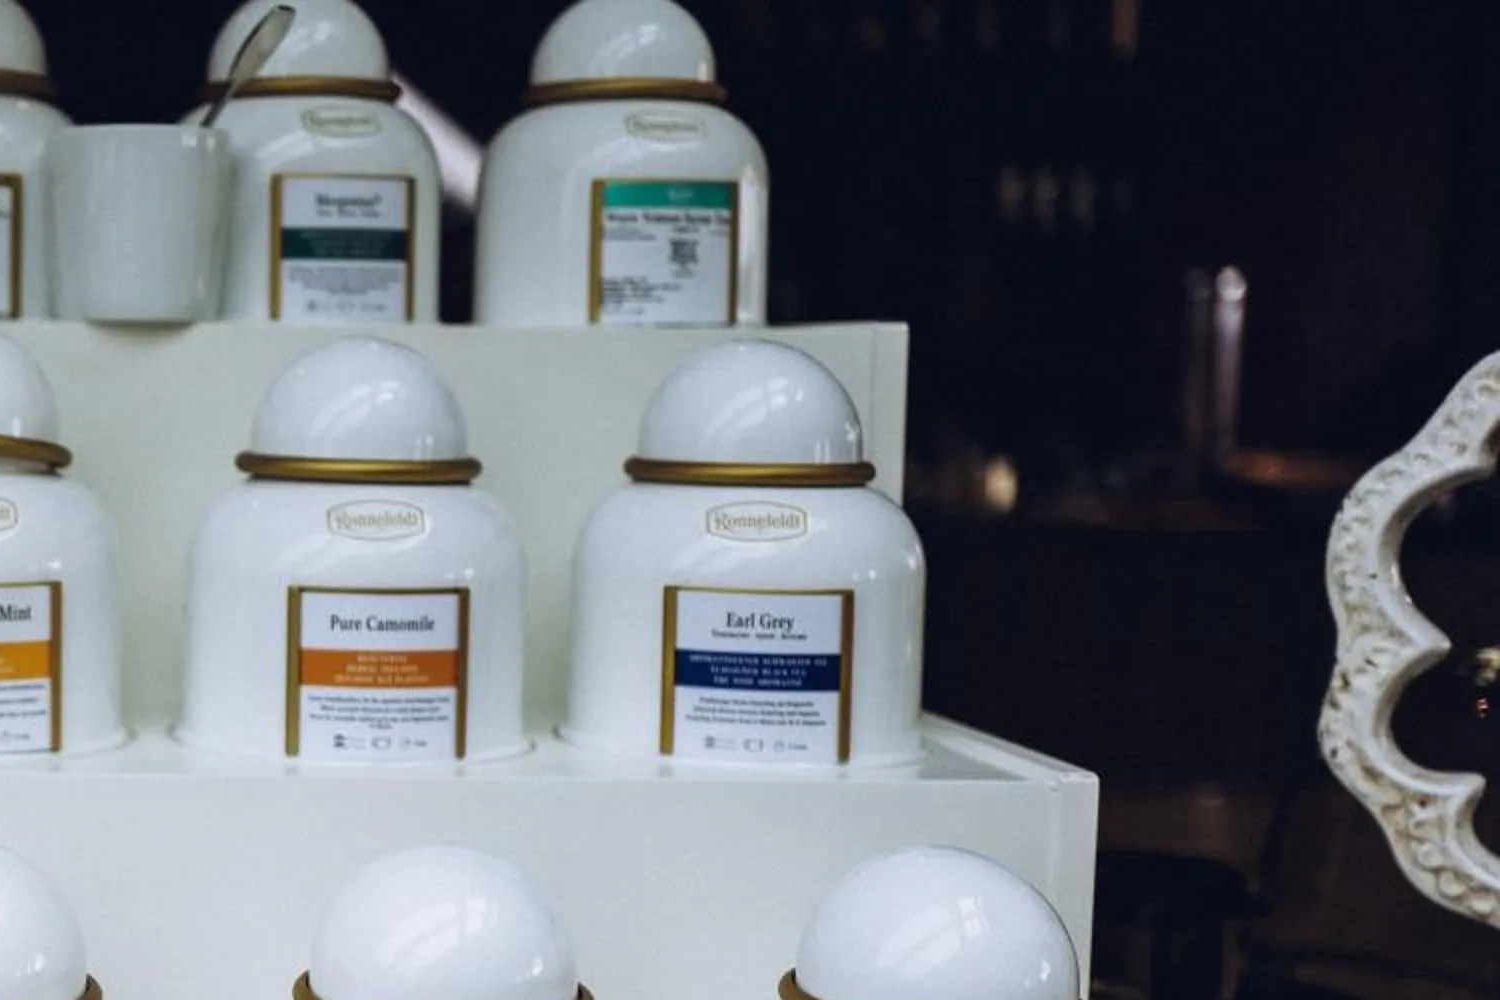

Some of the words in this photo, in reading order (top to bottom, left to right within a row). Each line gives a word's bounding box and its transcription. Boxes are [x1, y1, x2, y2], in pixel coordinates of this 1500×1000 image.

[329, 613, 362, 631] Pure
[366, 614, 436, 632] Camomile
[726, 611, 755, 628] Earl
[759, 612, 796, 632] Grey
